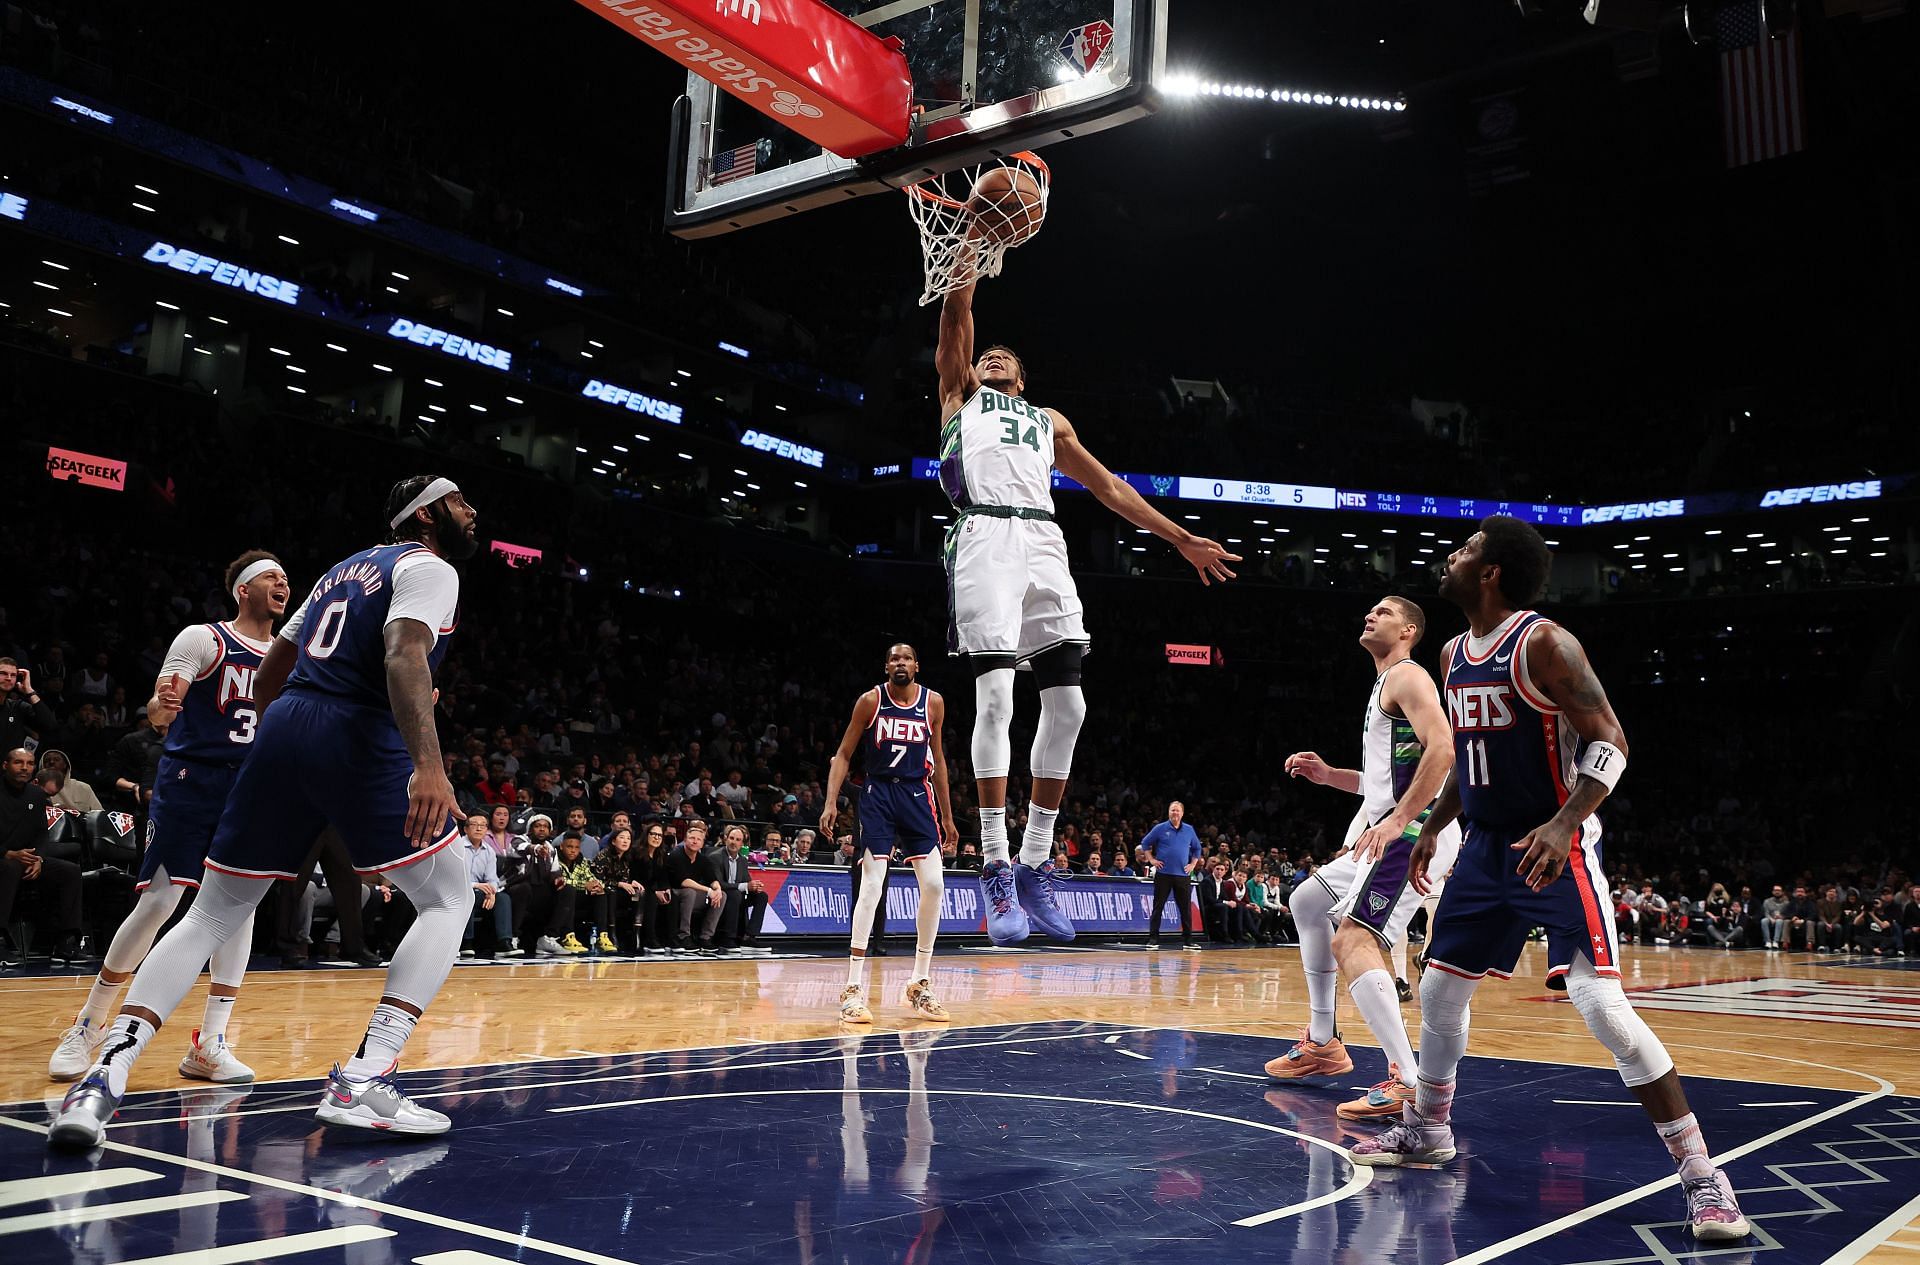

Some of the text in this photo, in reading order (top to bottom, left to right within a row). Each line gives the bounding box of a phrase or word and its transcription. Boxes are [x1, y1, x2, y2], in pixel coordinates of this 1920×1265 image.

[1091, 29, 1103, 47] 75
[142, 242, 300, 305] DEFENSE
[388, 318, 512, 371] DEFENSE
[582, 380, 683, 424] DEFENSE
[981, 392, 1049, 435] BUCKS
[1000, 417, 1041, 452] 34
[740, 429, 824, 468] DEFENSE
[52, 456, 122, 483] SEATGEEK
[888, 465, 900, 474] PM
[1213, 483, 1224, 497] 0
[1245, 484, 1271, 495] 8:38
[1293, 489, 1303, 503] 5
[1337, 492, 1367, 509] NETS
[1760, 480, 1881, 507] DEFENSE
[1558, 507, 1574, 515] AST
[1581, 500, 1684, 524] DEFENSE
[312, 562, 384, 603] DRUMMOND
[305, 599, 348, 659] 0
[1168, 649, 1208, 660] SEATGEEK
[1447, 685, 1513, 730] NETS
[229, 707, 258, 744] 3
[876, 717, 926, 744] NETS
[888, 744, 908, 768] 7
[1466, 739, 1489, 786] 11
[1593, 754, 1609, 771] 11
[800, 886, 849, 924] NBA App
[954, 888, 977, 919] APP
[1096, 892, 1117, 920] THE
[1115, 893, 1133, 920] APP
